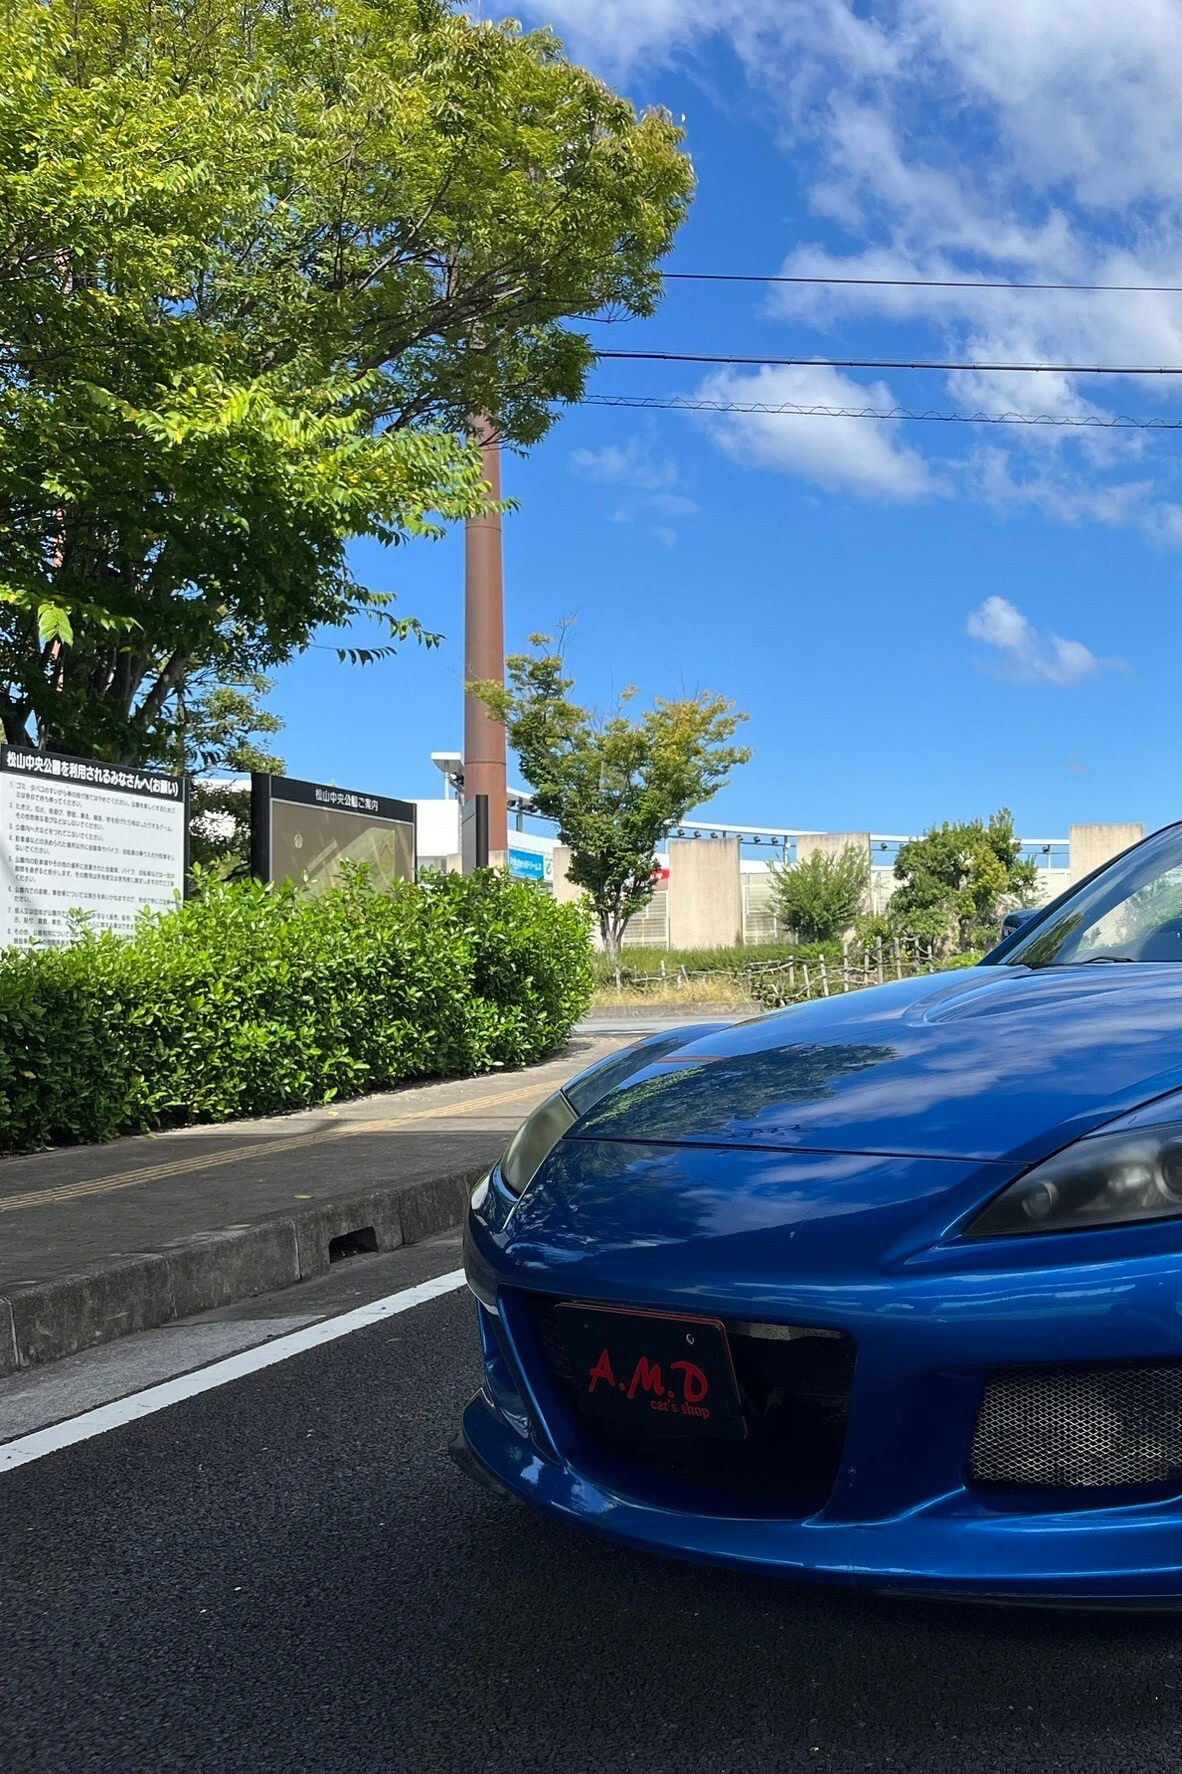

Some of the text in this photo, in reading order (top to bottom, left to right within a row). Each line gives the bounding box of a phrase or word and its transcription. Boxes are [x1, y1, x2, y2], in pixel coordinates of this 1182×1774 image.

[315, 788, 379, 812] 松山中央公園ご案内
[588, 1349, 708, 1403] A.M.D
[650, 1399, 710, 1420] car's shop
